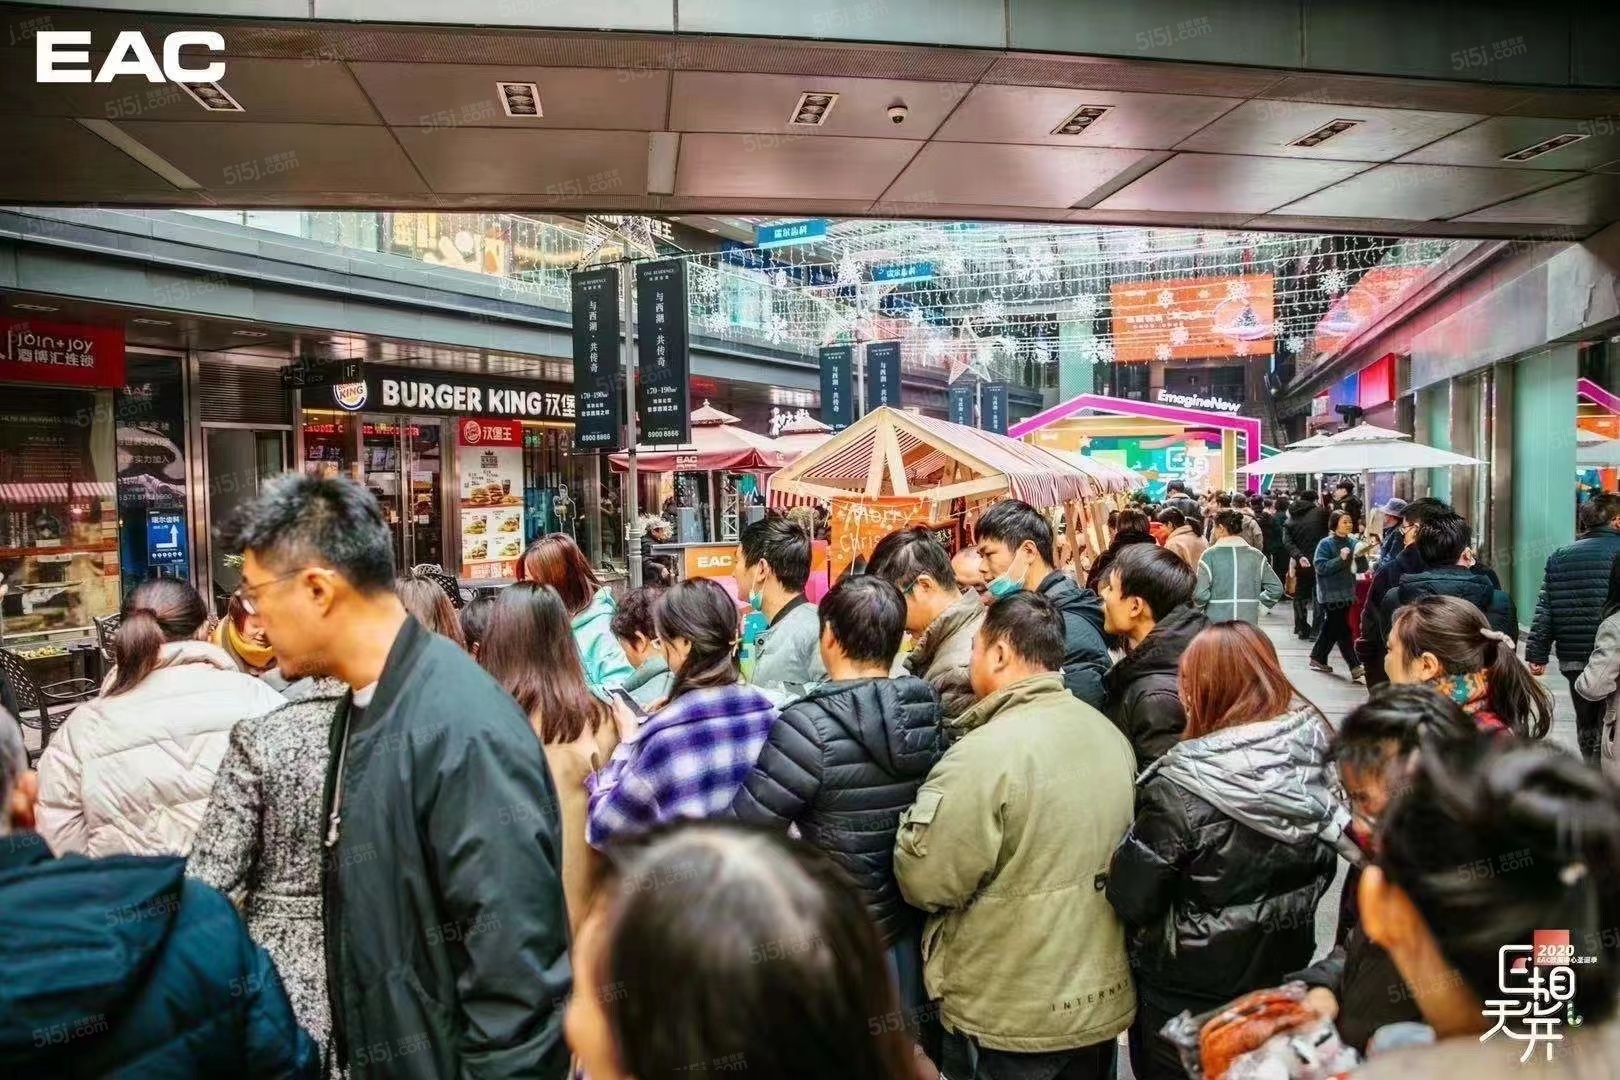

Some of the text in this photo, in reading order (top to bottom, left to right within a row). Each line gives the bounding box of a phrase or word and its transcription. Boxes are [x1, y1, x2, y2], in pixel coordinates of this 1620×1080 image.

[340, 385, 363, 399] KING
[382, 379, 542, 416] BURGER KING
[482, 426, 512, 441] 汉堡王
[676, 456, 698, 464] EAC
[697, 555, 732, 568] EAC
